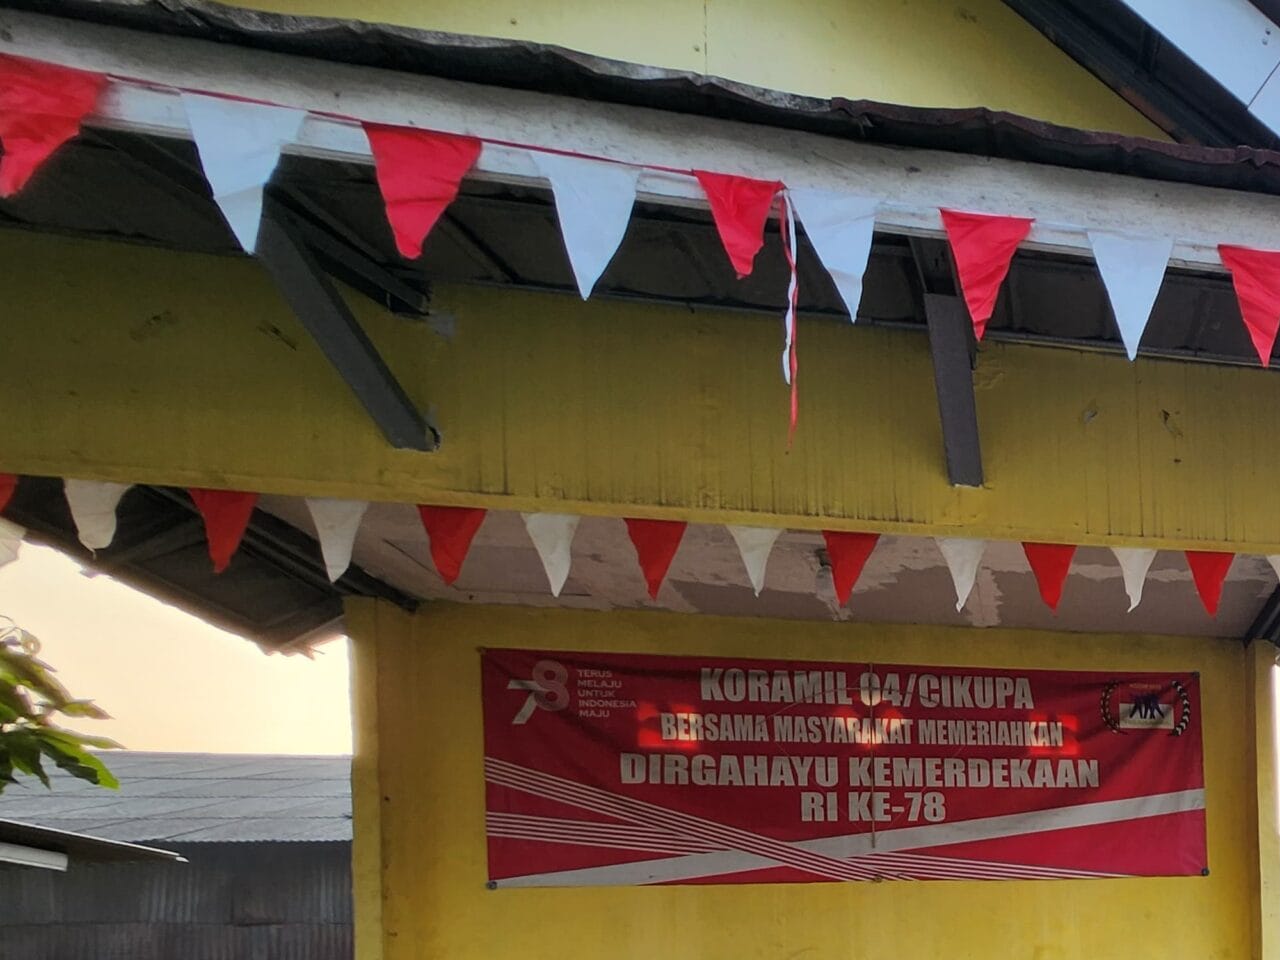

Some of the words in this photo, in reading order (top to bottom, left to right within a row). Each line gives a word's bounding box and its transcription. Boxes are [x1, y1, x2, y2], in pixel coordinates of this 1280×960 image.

[577, 669, 612, 678] TERUS
[577, 680, 622, 688] MELAJU
[701, 667, 852, 705] KORAMIL
[860, 672, 1034, 709] 04/CIKUPA
[578, 690, 615, 698] UNTUK
[578, 700, 637, 708] INDONESIA
[579, 710, 610, 718] MAJU
[661, 712, 769, 742] BERSAMA
[774, 716, 913, 744] MASYARAKAT
[918, 719, 1063, 747] MEMERIAHKAN
[620, 753, 839, 787] DIRGAHAYU
[849, 757, 1100, 788] KEMERDEKAAN
[801, 791, 838, 822] RI
[848, 791, 946, 822] KE-78
